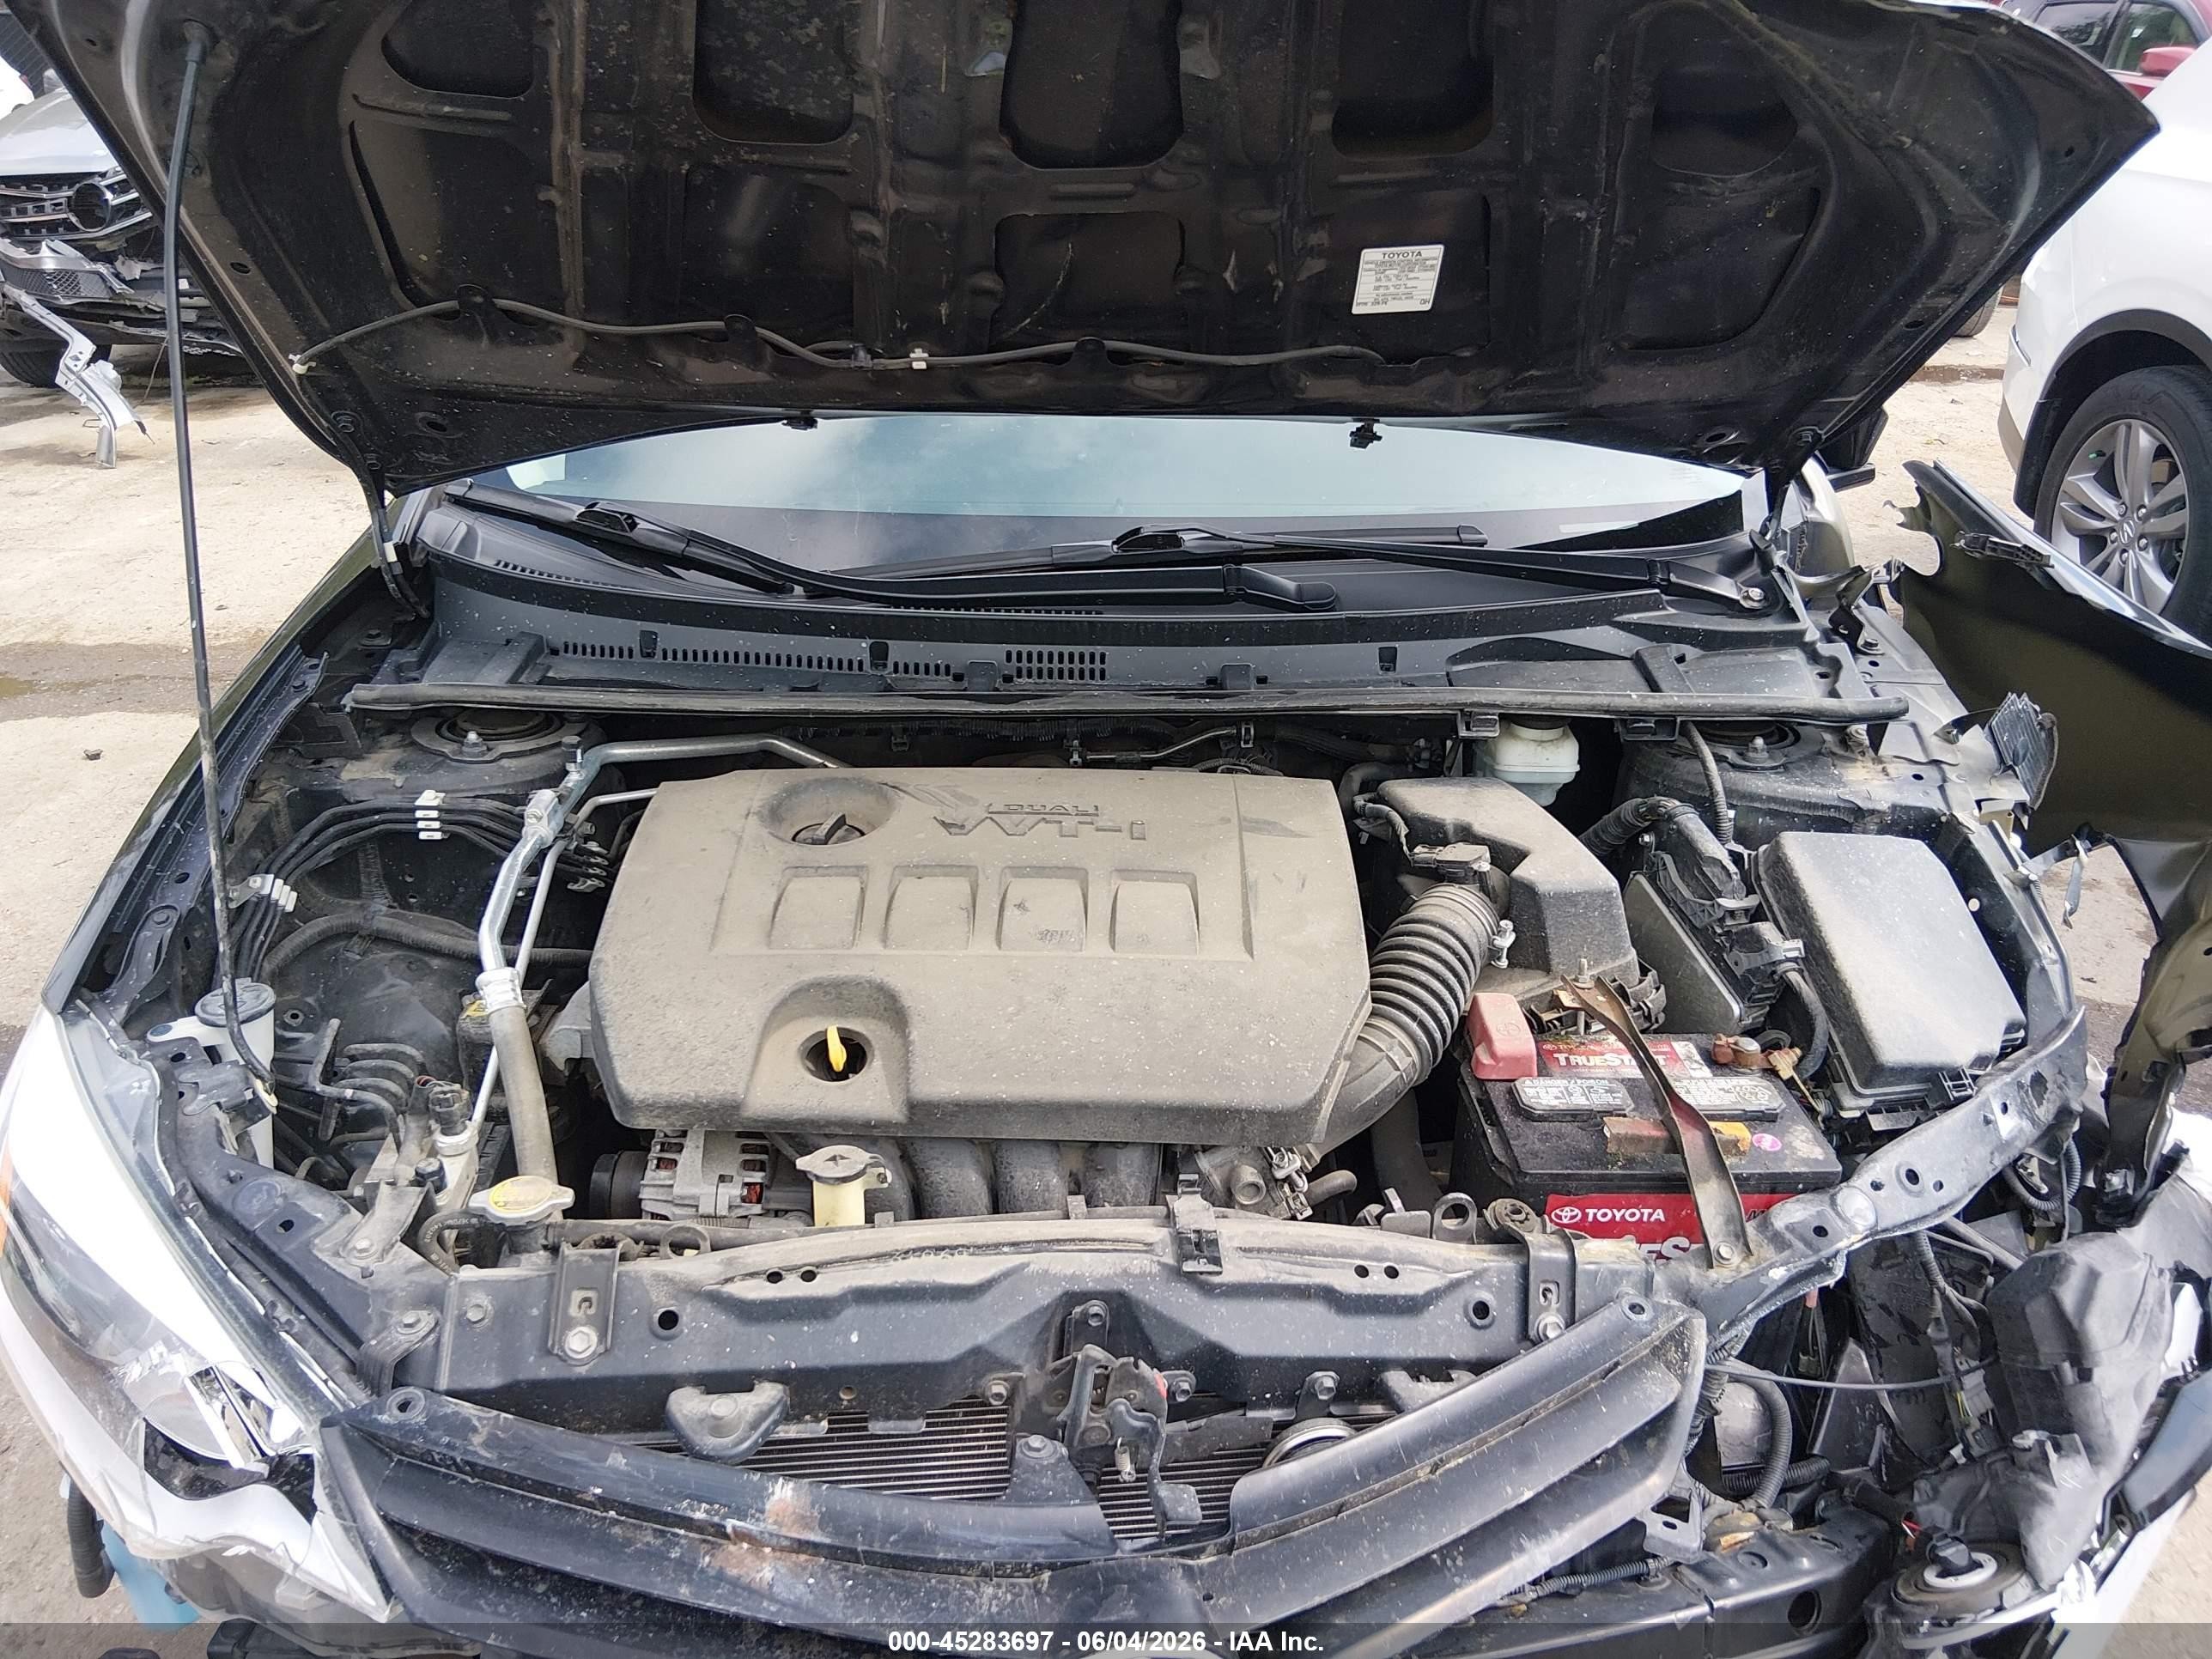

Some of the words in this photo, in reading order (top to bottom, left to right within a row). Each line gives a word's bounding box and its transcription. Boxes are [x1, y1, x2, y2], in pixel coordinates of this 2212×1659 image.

[1382, 251, 1423, 259] TOYOTA
[1003, 804, 1090, 812] DUAL
[1585, 1208, 1666, 1223] TOYOTA
